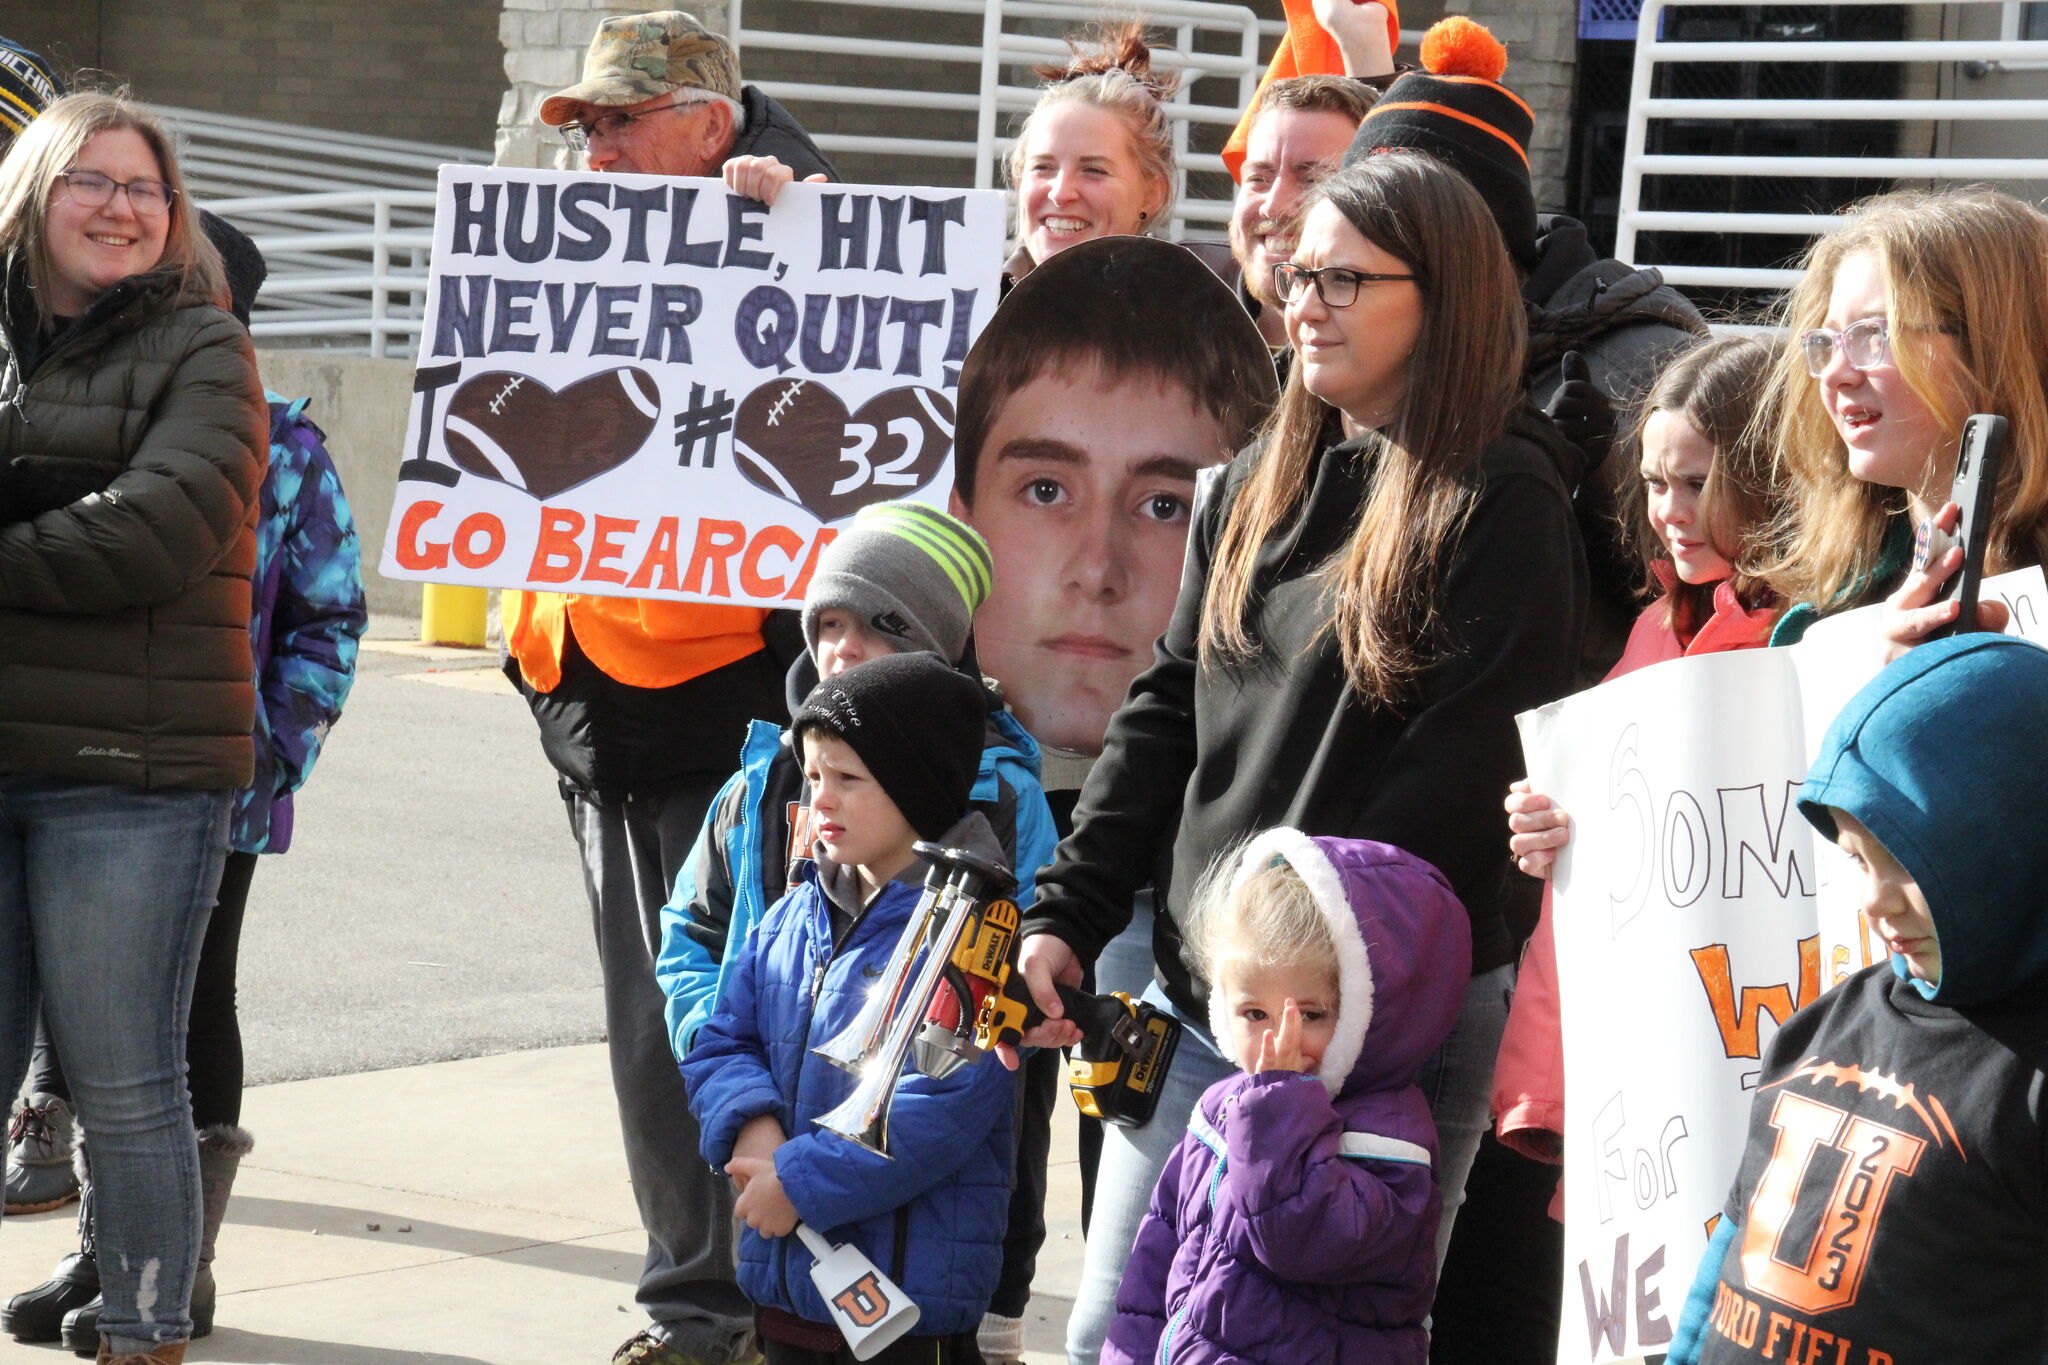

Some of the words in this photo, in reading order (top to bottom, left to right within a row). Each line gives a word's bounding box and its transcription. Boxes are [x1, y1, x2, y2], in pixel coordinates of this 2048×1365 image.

[452, 182, 790, 280] HUSTLE,
[818, 193, 966, 277] HIT
[431, 275, 703, 364] NEVER
[735, 285, 978, 388] QUIT!
[398, 361, 462, 488] I
[830, 416, 926, 497] 32
[1817, 1135, 1889, 1291] 2023
[831, 1270, 891, 1328] U
[1579, 1232, 1674, 1363] WE
[1709, 1280, 1761, 1349] FORD
